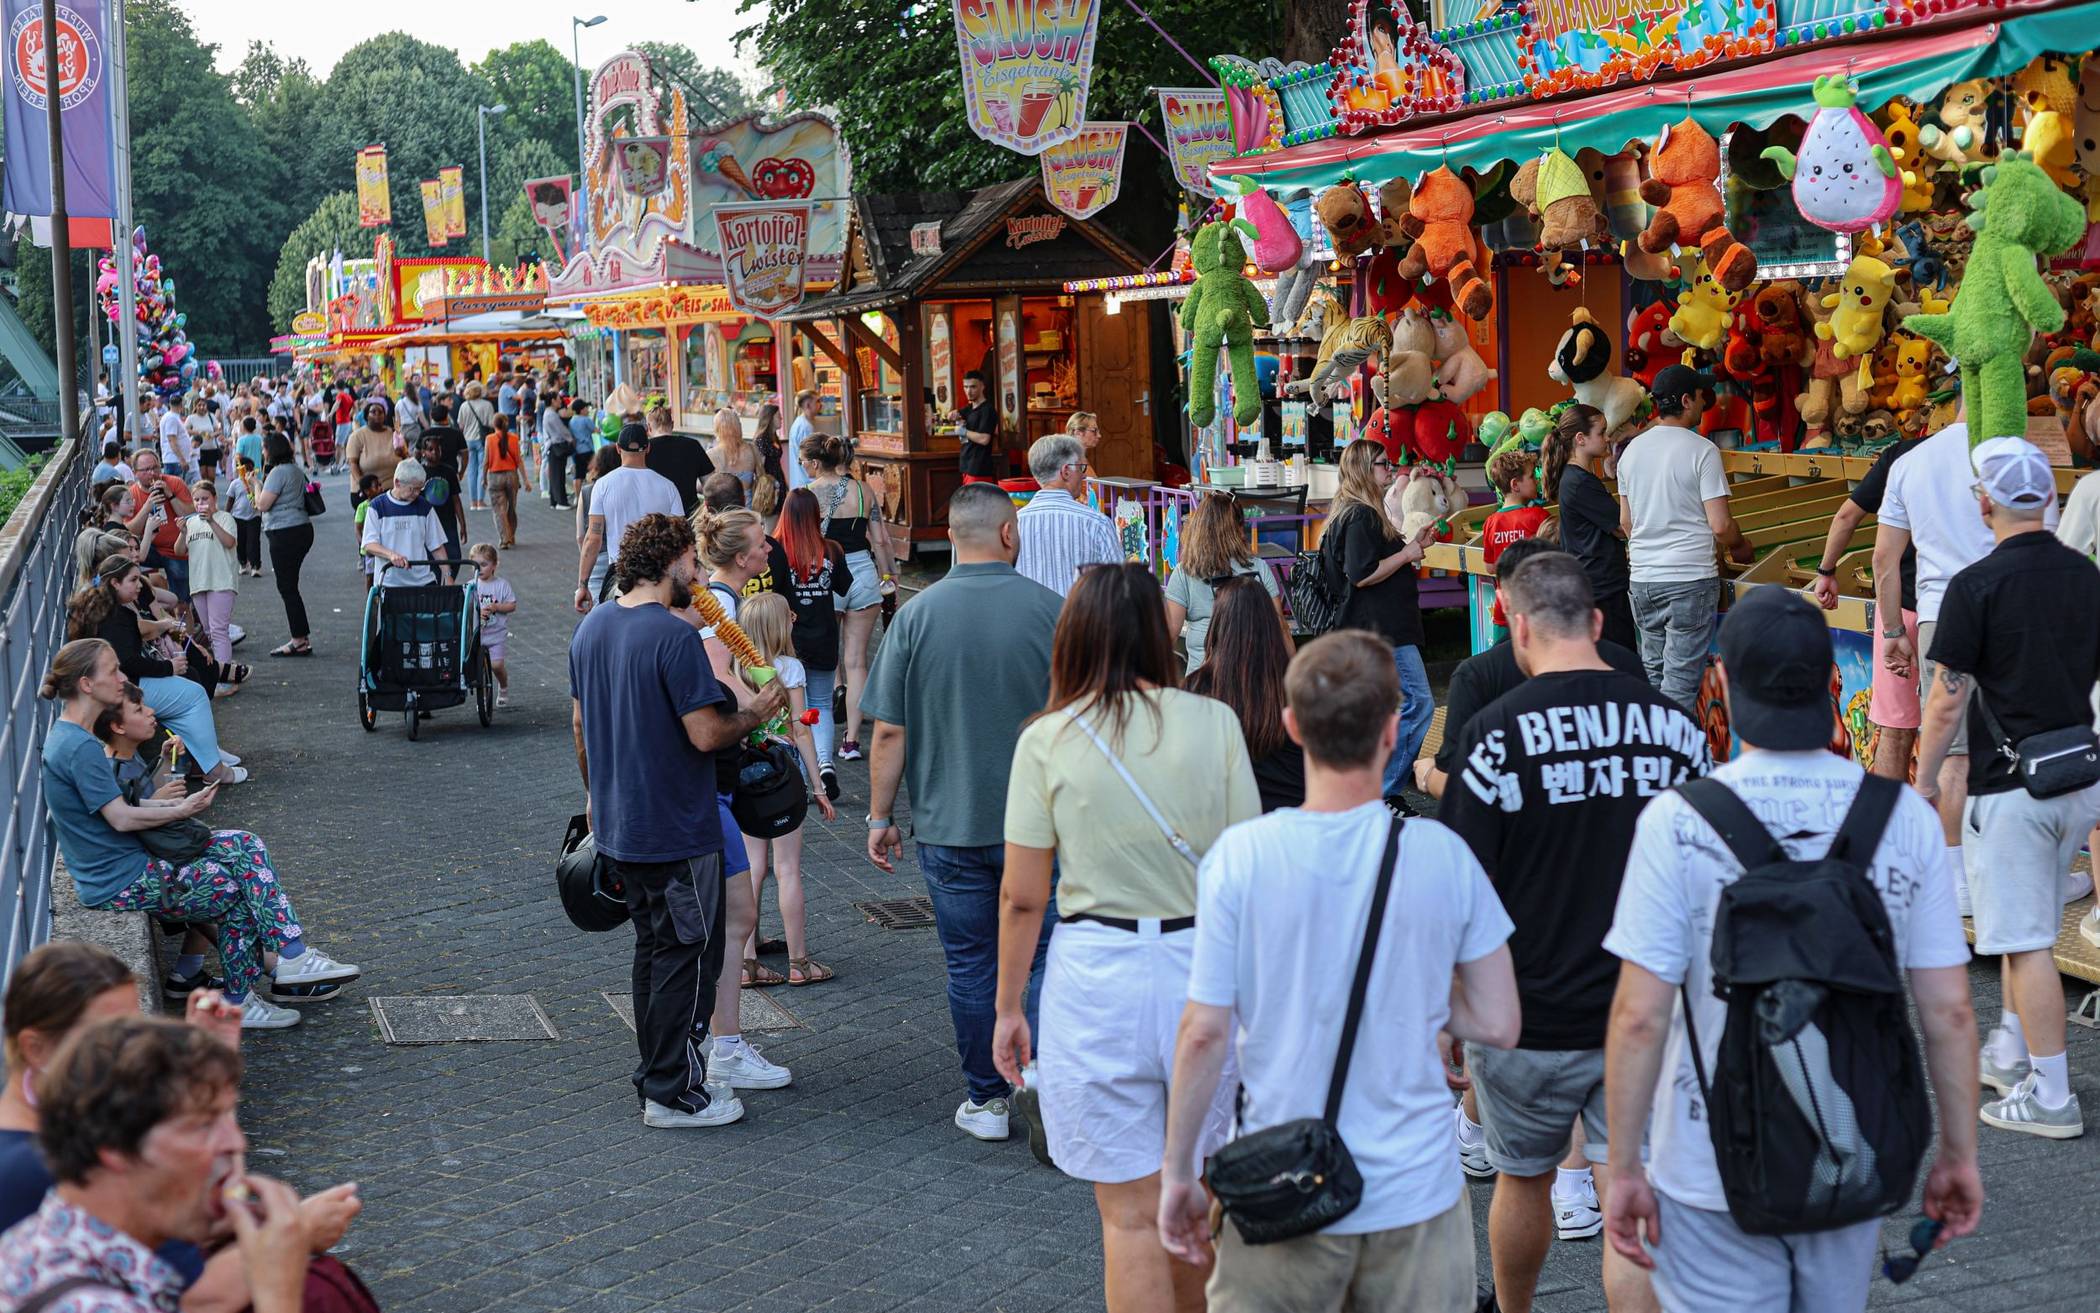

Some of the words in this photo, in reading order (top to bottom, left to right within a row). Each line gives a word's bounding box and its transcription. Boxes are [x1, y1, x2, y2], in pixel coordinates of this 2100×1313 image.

[959, 0, 1094, 67] SLUSH
[976, 61, 1073, 88] Eisgetränk
[1166, 96, 1232, 145] SLUS
[1179, 144, 1233, 158] Eisgeträn
[720, 215, 806, 251] Kartoffel-
[727, 249, 804, 279] Twister
[451, 298, 541, 312] Currywurst
[1494, 530, 1525, 544] ZIYECH
